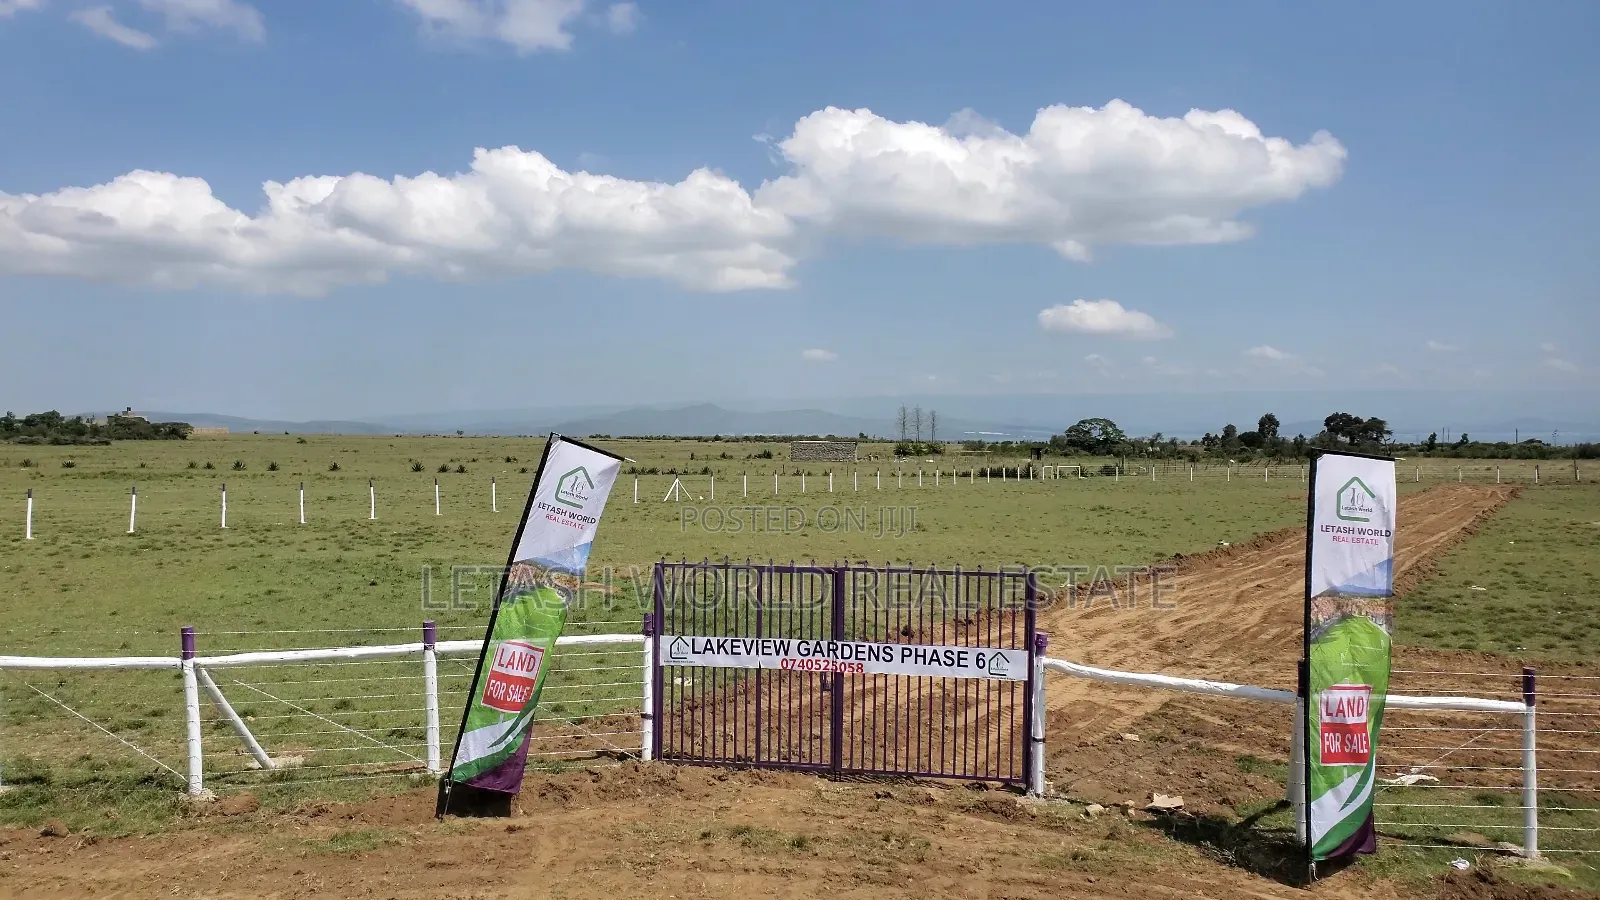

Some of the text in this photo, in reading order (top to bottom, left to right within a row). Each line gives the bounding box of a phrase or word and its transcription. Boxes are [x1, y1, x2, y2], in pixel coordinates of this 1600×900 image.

[538, 502, 596, 525] LETASH WORLD
[545, 514, 584, 530] REAL ESTATE
[1320, 524, 1392, 538] LETASH WORLD
[1332, 535, 1378, 545] REAL ESTATE
[498, 648, 536, 672] LAND
[691, 638, 986, 670] LAKEVIEW GARDENS PHASE 6
[780, 658, 864, 674] 0740525058
[488, 680, 530, 702] FOR SALE
[1325, 695, 1365, 718] LAND
[1324, 732, 1368, 753] FOR SALE
